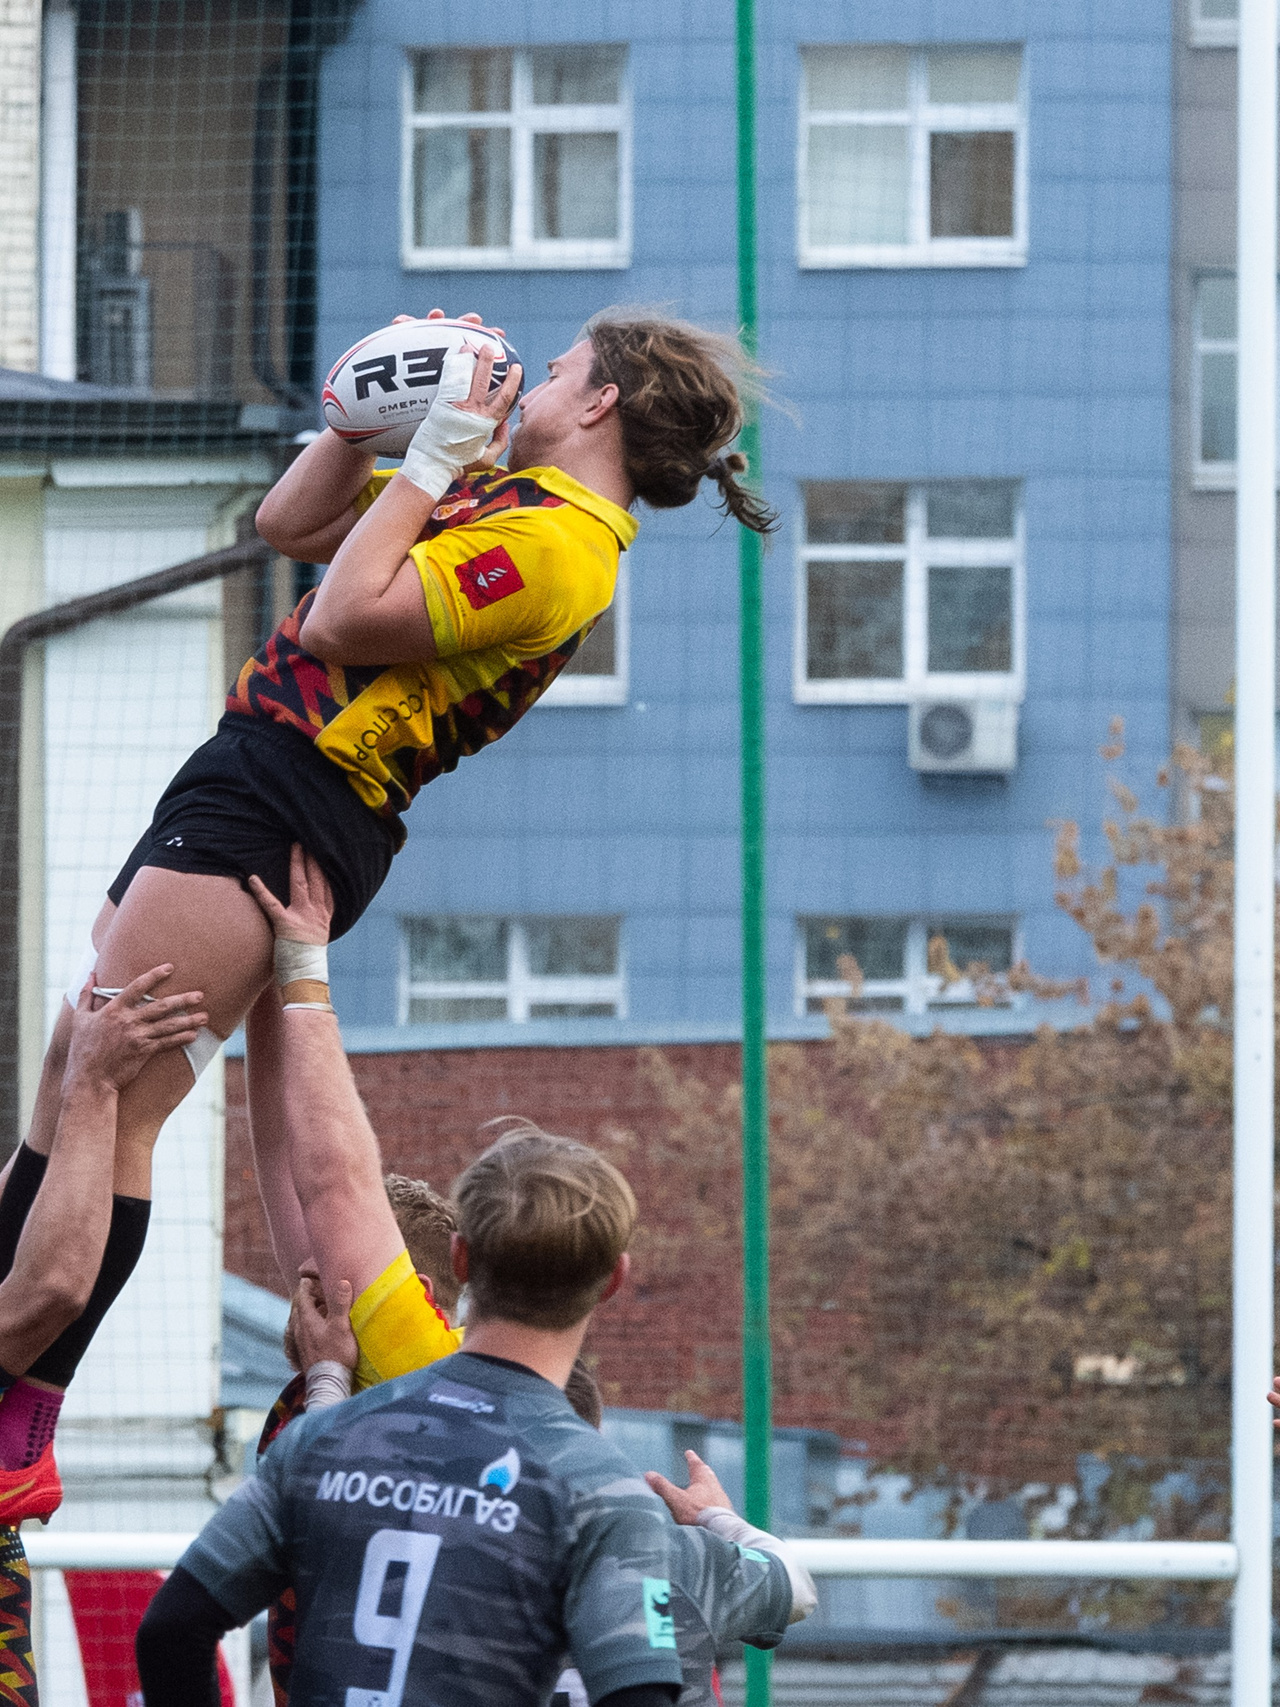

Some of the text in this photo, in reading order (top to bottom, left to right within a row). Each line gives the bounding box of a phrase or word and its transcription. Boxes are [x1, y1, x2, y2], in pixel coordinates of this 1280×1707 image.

[353, 694, 423, 760] ОССПОР
[317, 1470, 519, 1533] МОСОБЛГАЗ
[344, 1529, 442, 1707] 9
